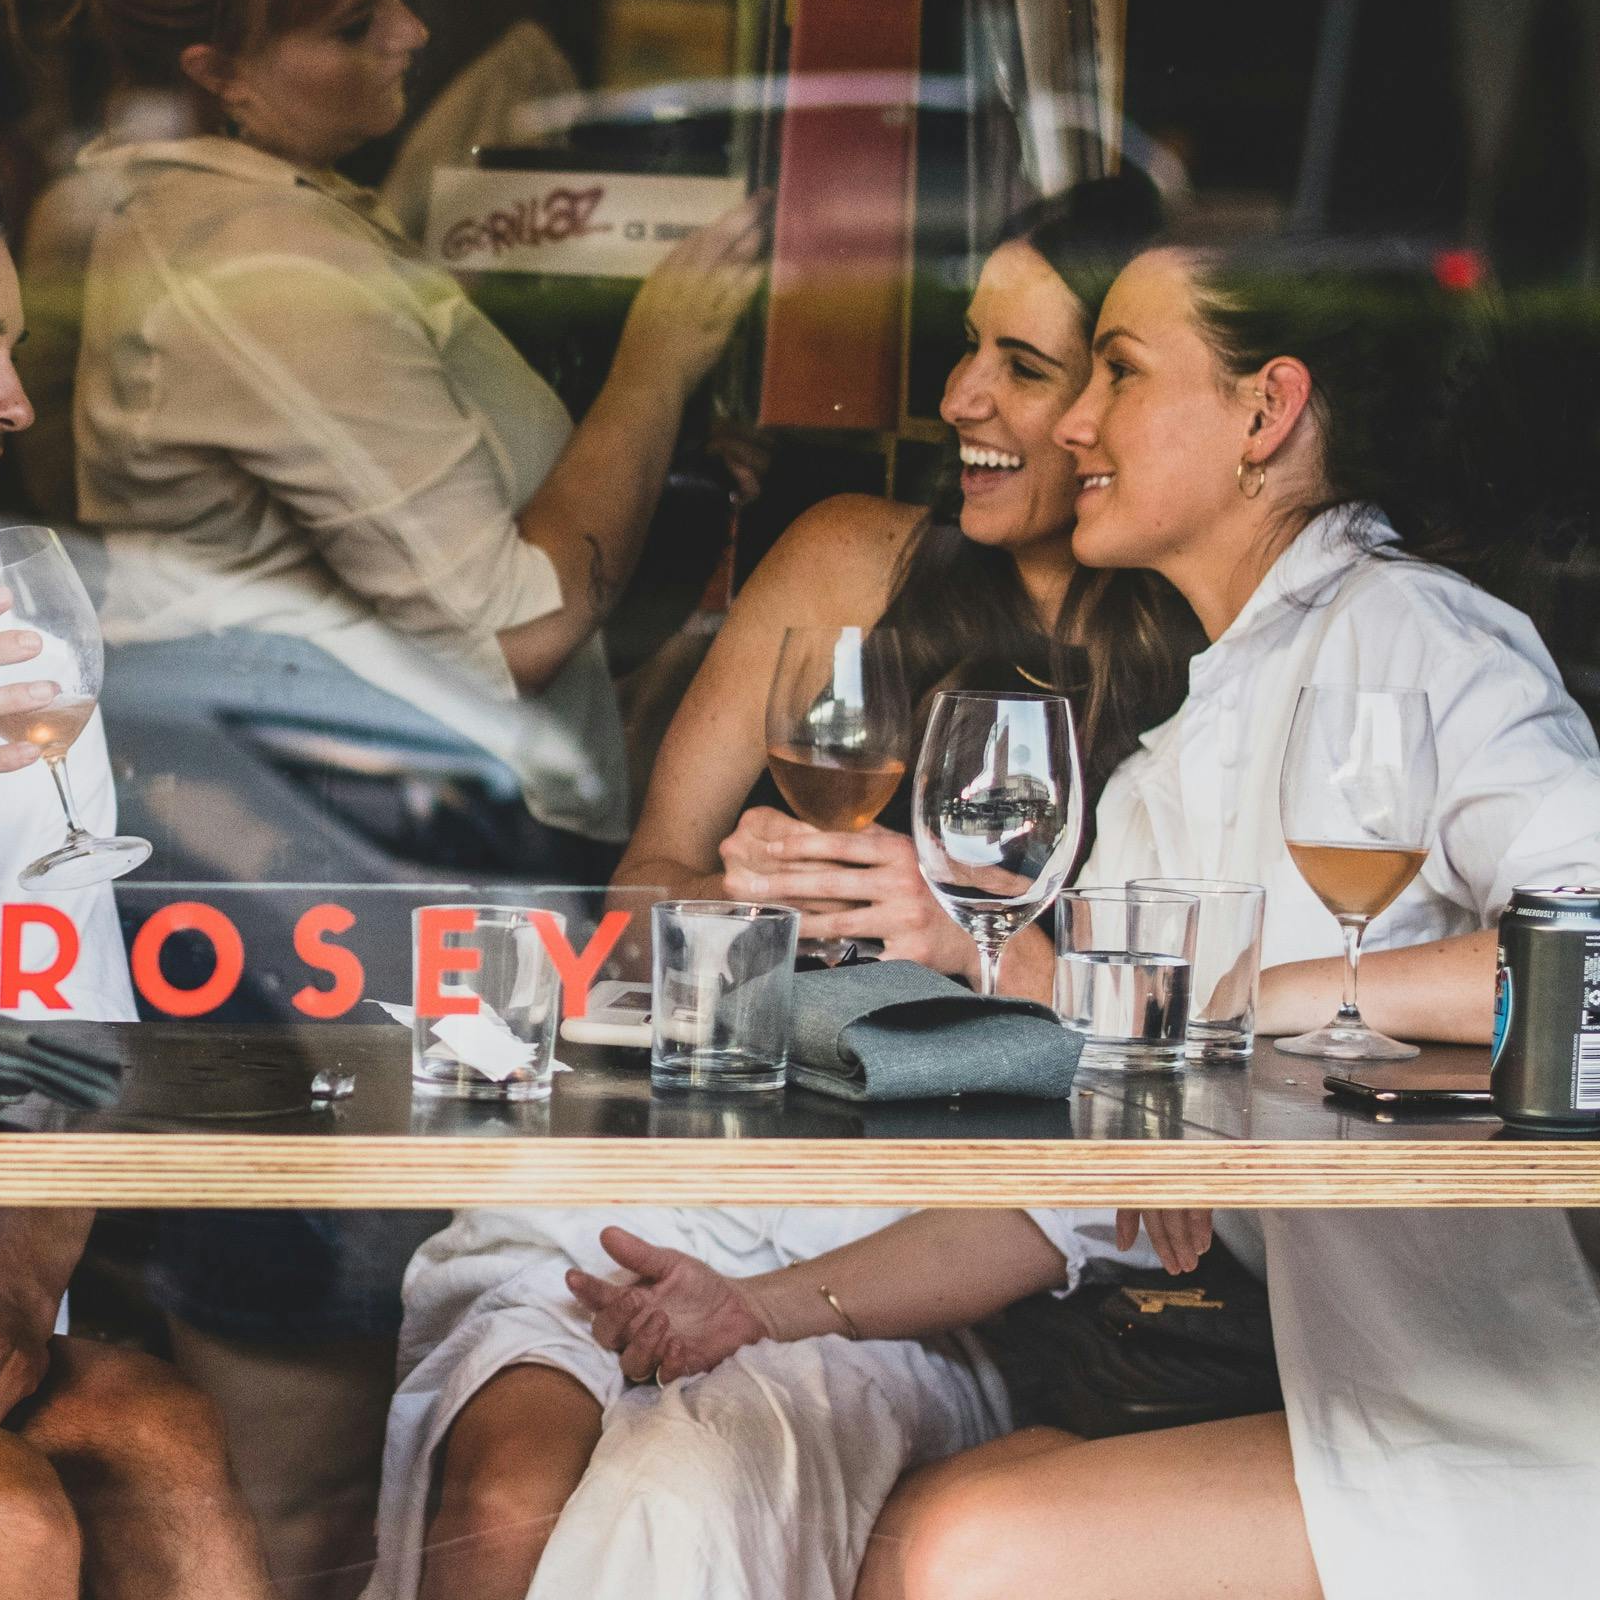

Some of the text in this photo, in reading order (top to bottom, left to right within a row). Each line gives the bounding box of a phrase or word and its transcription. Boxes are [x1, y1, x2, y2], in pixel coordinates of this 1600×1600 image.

[1516, 907, 1555, 919] DANGEROUSLY
[1556, 911, 1593, 920] DRINKABLE
[1582, 987, 1591, 1008] please
